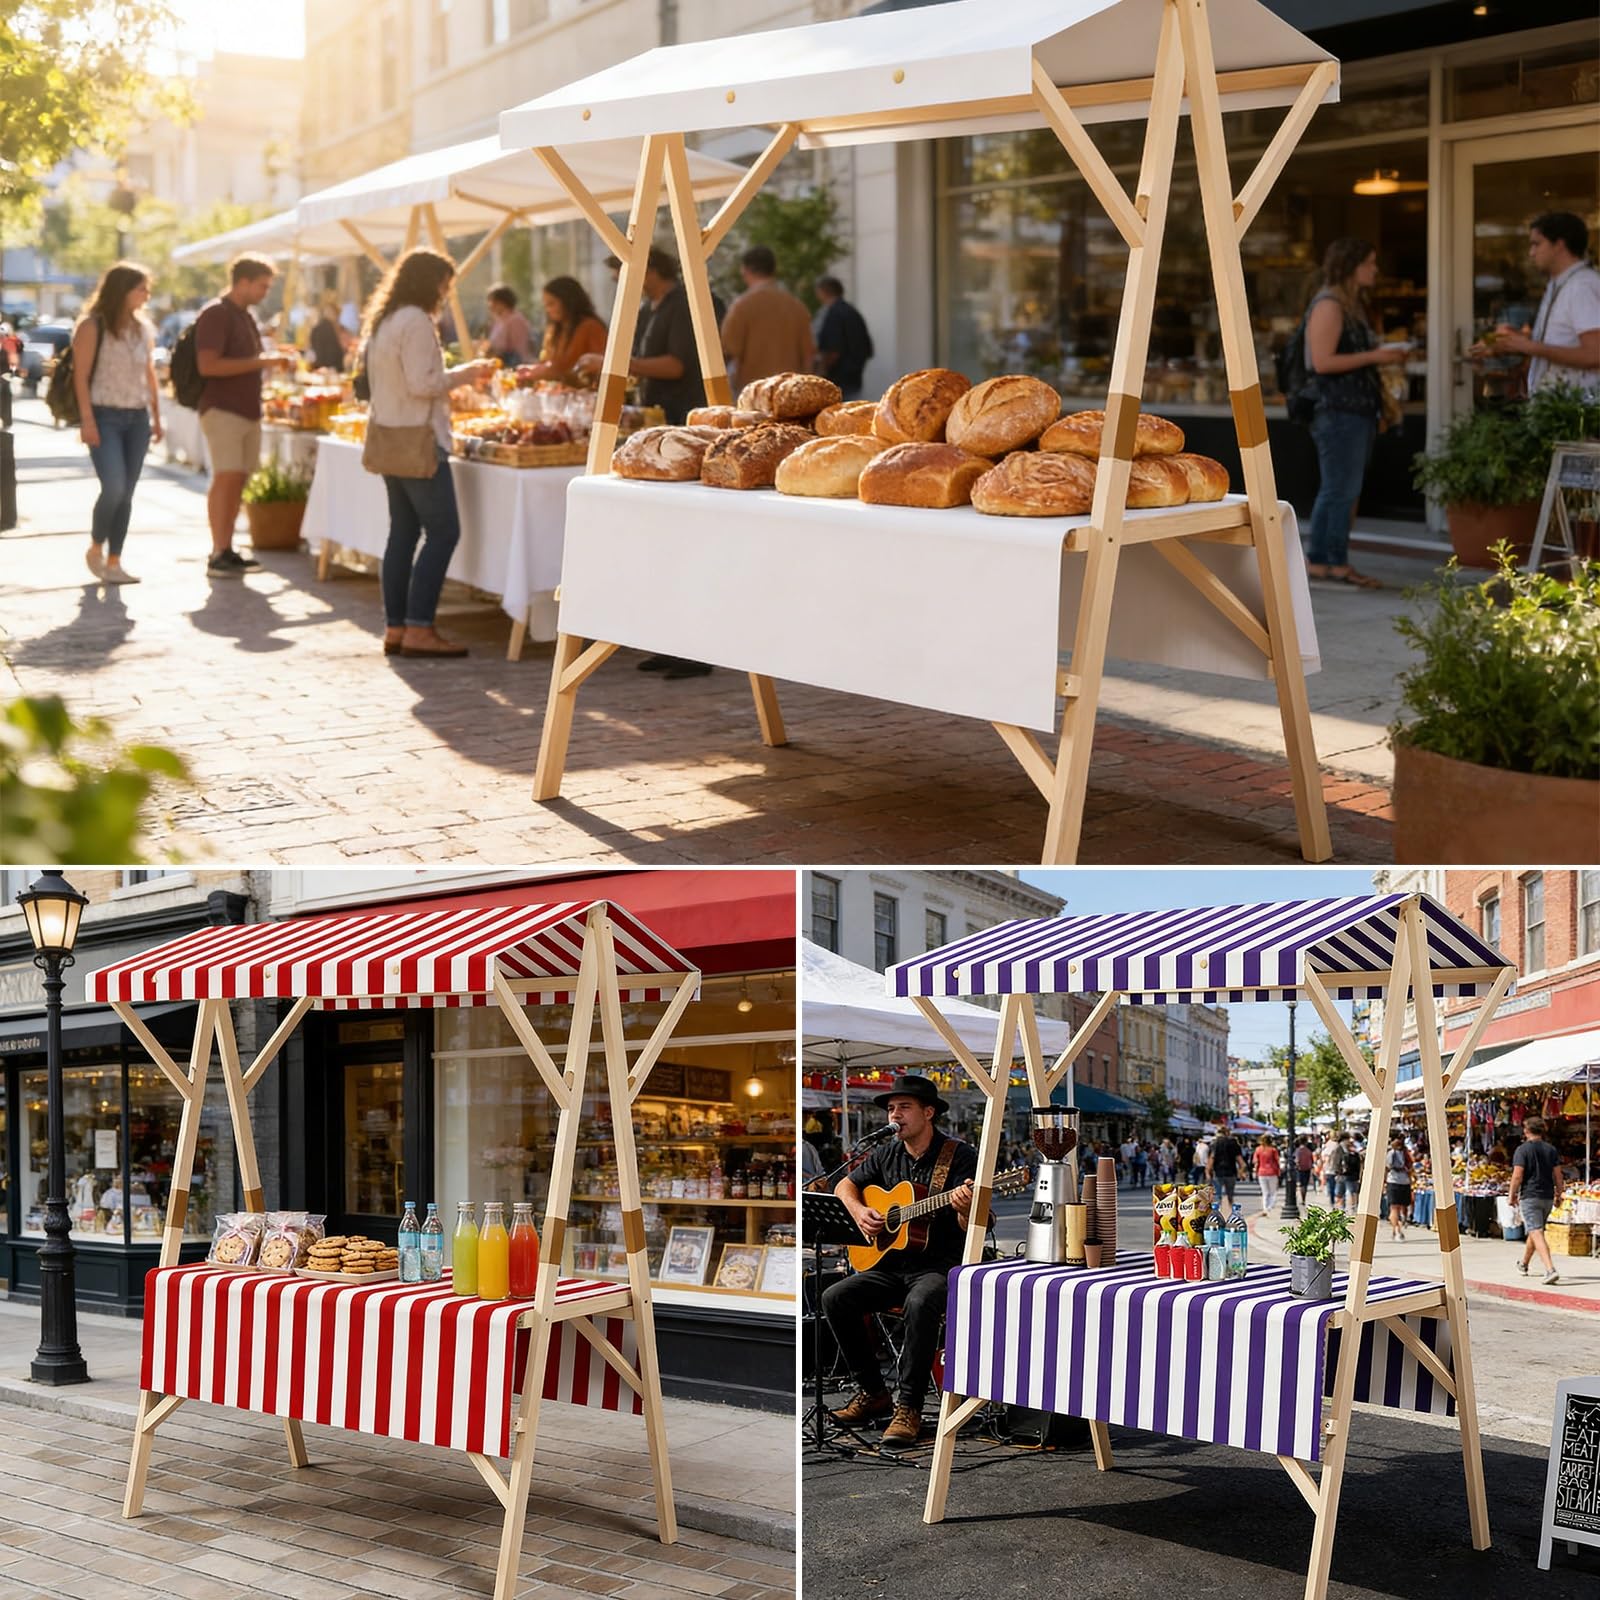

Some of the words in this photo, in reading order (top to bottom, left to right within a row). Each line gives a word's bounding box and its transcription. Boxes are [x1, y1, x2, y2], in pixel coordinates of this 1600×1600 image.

[1564, 1426, 1599, 1445] EAT
[1562, 1441, 1597, 1459] MEAT
[1557, 1485, 1592, 1513] STEAK
